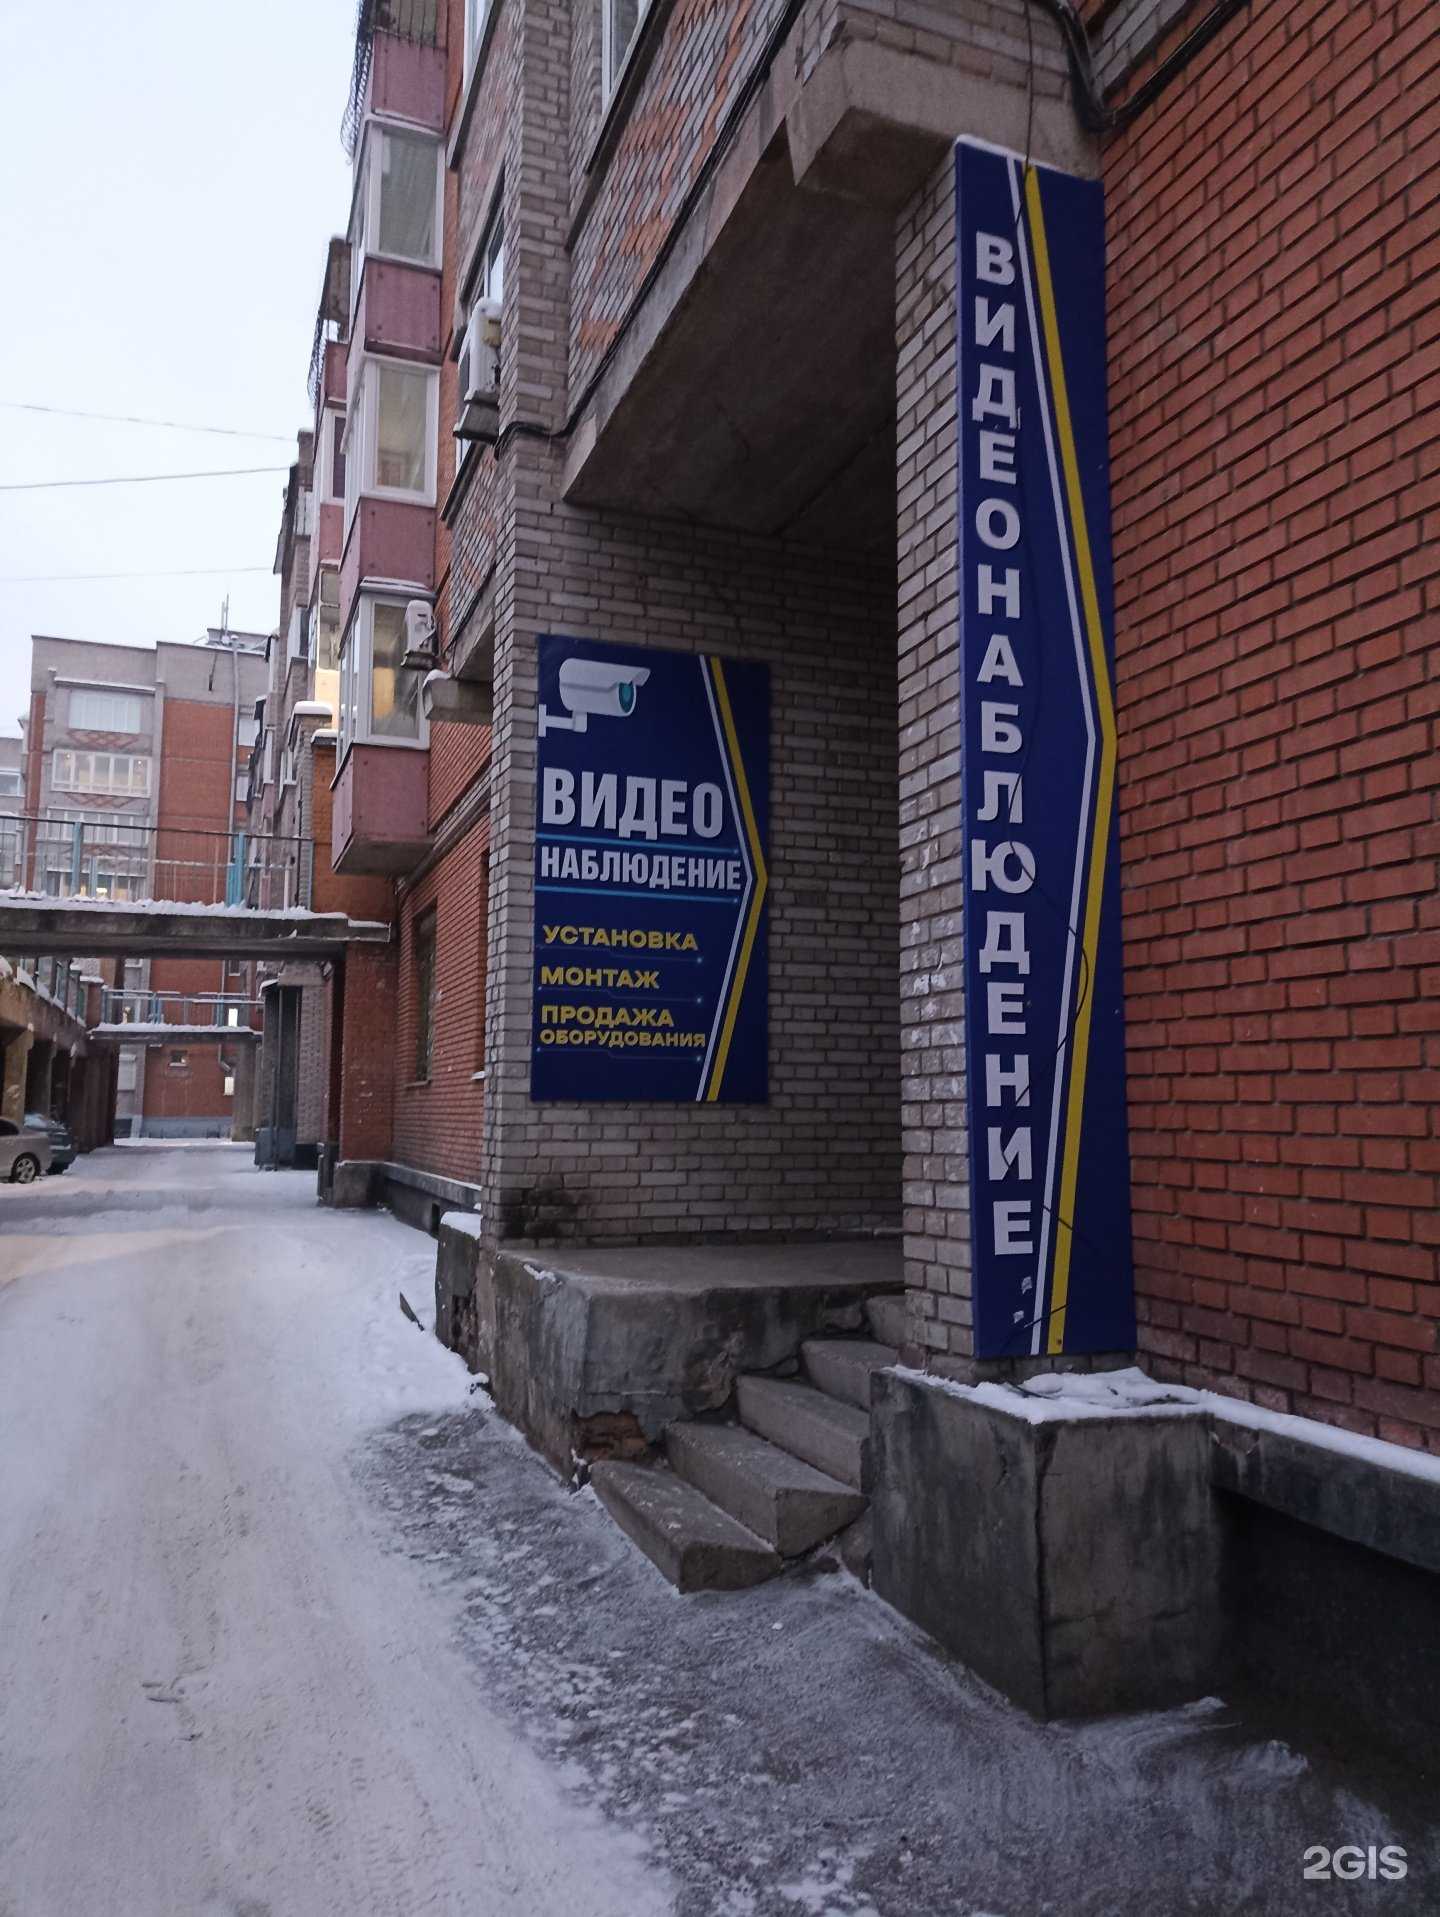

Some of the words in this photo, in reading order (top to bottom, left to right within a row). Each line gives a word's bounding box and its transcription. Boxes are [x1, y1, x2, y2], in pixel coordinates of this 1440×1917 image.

[971, 231, 1036, 1255] ВИДЕОНАБЛЮДЕНИЕ
[542, 767, 723, 840] ВИДЕО
[541, 846, 741, 890] НАБЛЮДЕНИЕ
[542, 925, 699, 951] УСТАНОВКА
[541, 967, 660, 989] МОНТАЖ
[541, 1005, 674, 1028] ПРОДАЖА
[540, 1029, 706, 1049] ОБОРУДОВАНИЯ
